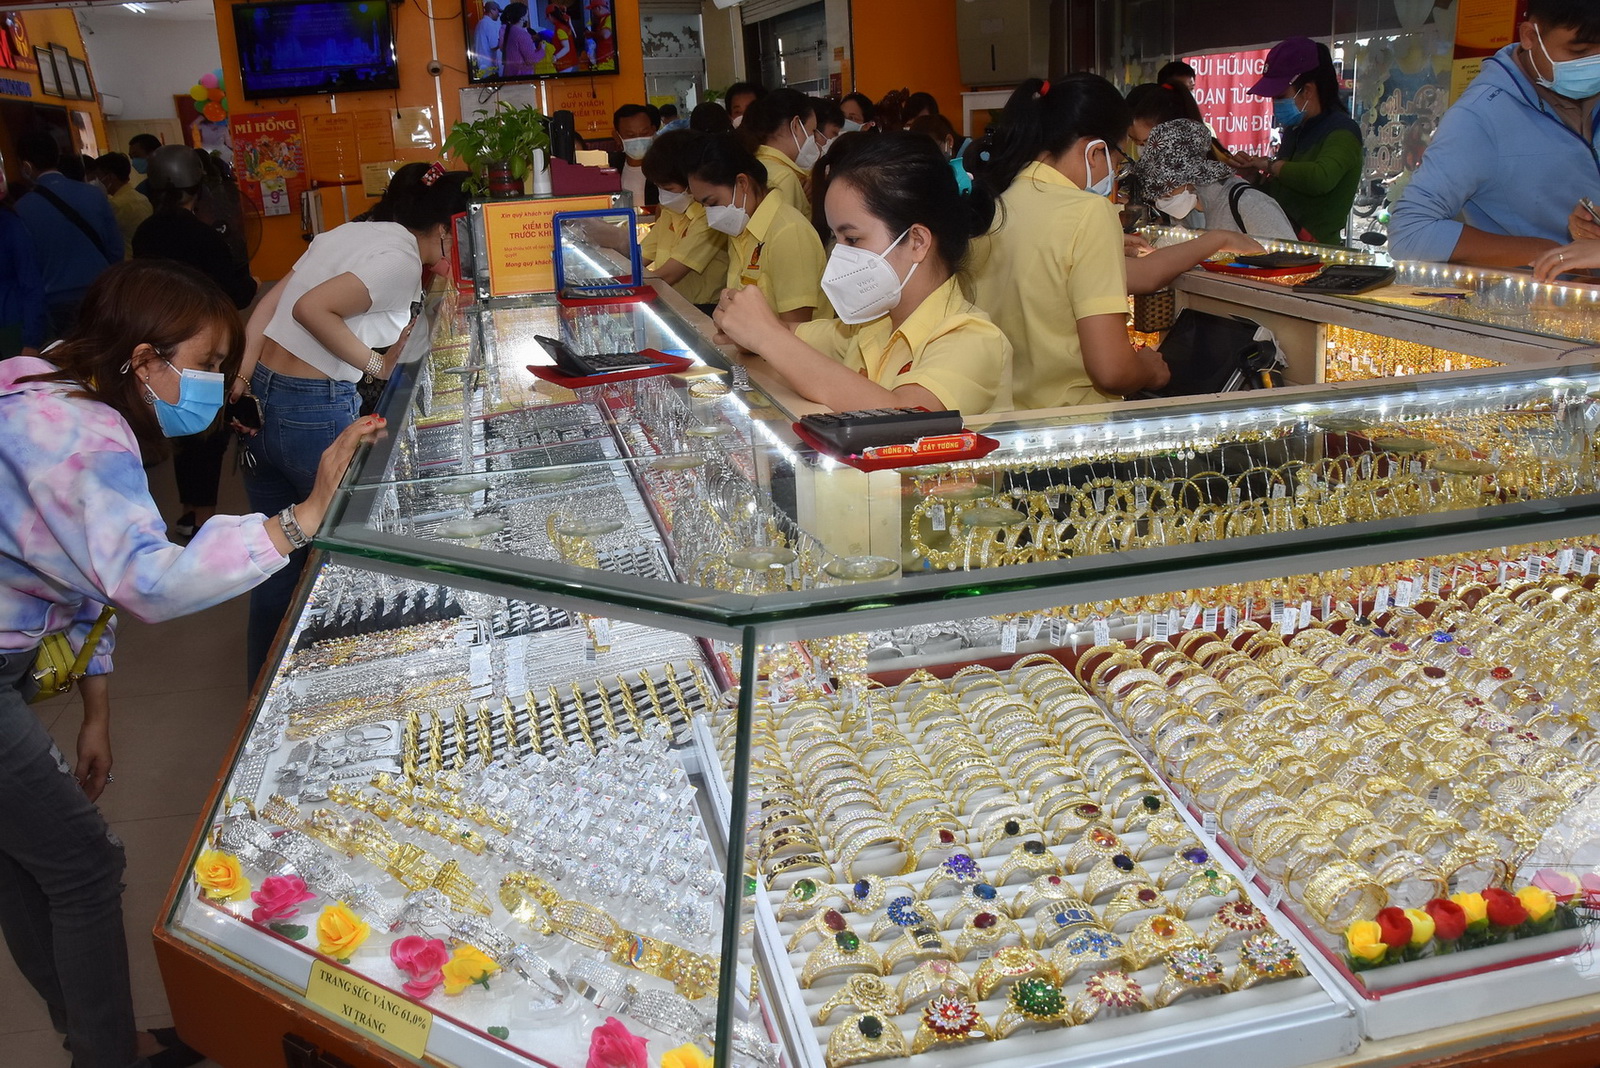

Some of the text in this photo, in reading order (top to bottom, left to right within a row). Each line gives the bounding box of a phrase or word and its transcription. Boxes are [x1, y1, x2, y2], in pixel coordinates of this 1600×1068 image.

[1190, 55, 1212, 75] BÙI
[1192, 87, 1225, 109] OẠN
[592, 109, 607, 117] TRA
[255, 116, 296, 133] HỒNG
[1217, 112, 1248, 133] TÙNG
[271, 190, 280, 204] 9
[509, 230, 537, 240] TRƯỚC
[319, 968, 427, 1030] TRANG SỨC VÀNG 61,0%
[341, 1003, 354, 1018] XI
